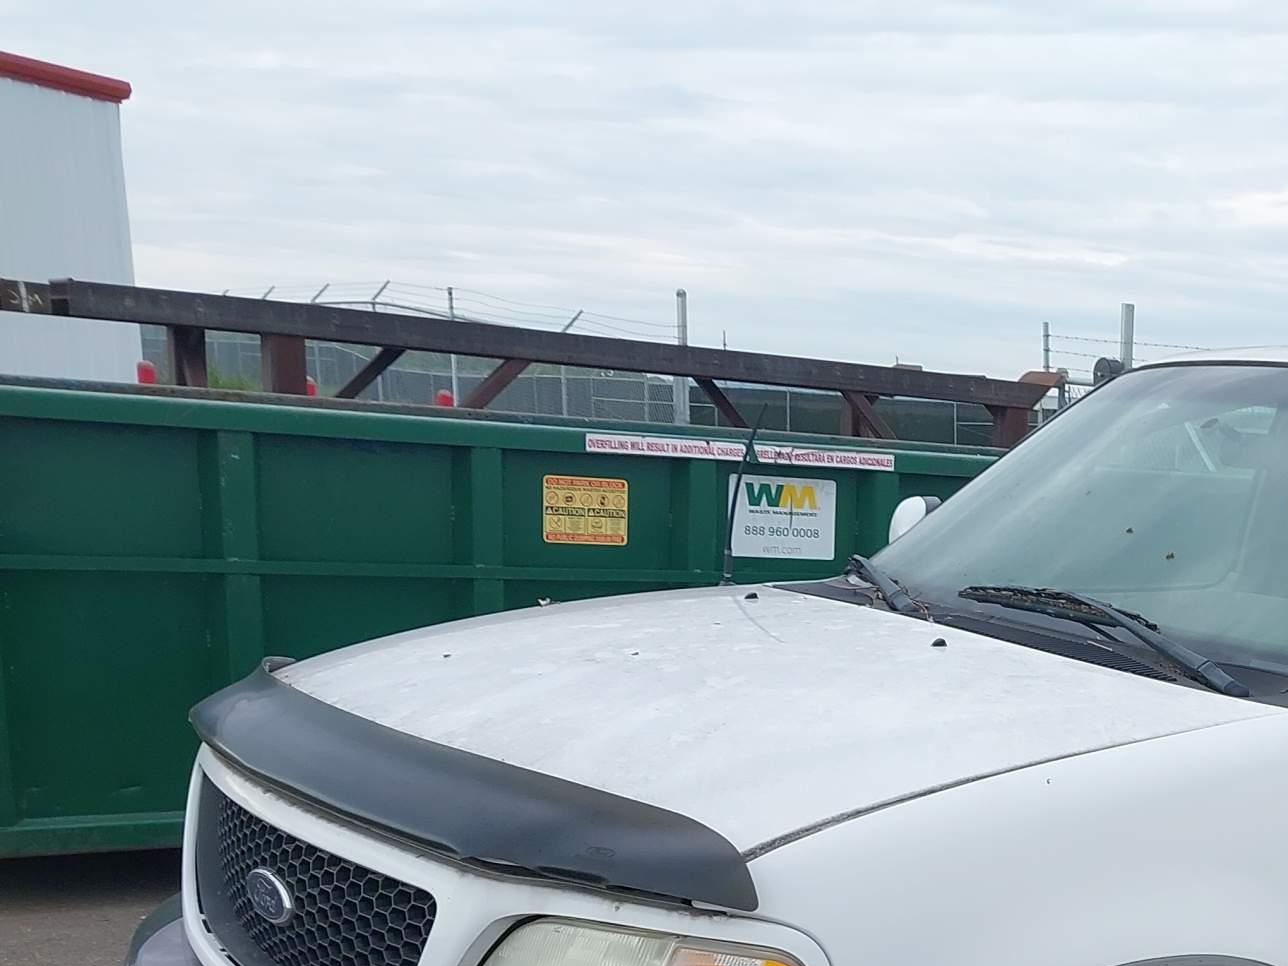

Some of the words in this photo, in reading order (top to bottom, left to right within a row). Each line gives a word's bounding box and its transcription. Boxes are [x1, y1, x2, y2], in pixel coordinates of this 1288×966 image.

[588, 438, 629, 450] OVERFILLING
[631, 441, 645, 451] WILL
[647, 441, 669, 453] RESULT
[672, 443, 679, 453] IN
[680, 443, 716, 456] ADDITIONAL
[717, 447, 744, 457] CHARGES
[827, 454, 835, 464] EN
[836, 455, 858, 465] CARGOS
[859, 456, 893, 468] ADICIONALES
[745, 482, 818, 511] WM
[553, 507, 585, 516] CAUTION
[594, 509, 625, 518] CAUTION
[744, 525, 766, 537] 888
[768, 526, 790, 538] 960
[792, 527, 820, 539] 0008
[762, 545, 801, 555] wm.com
